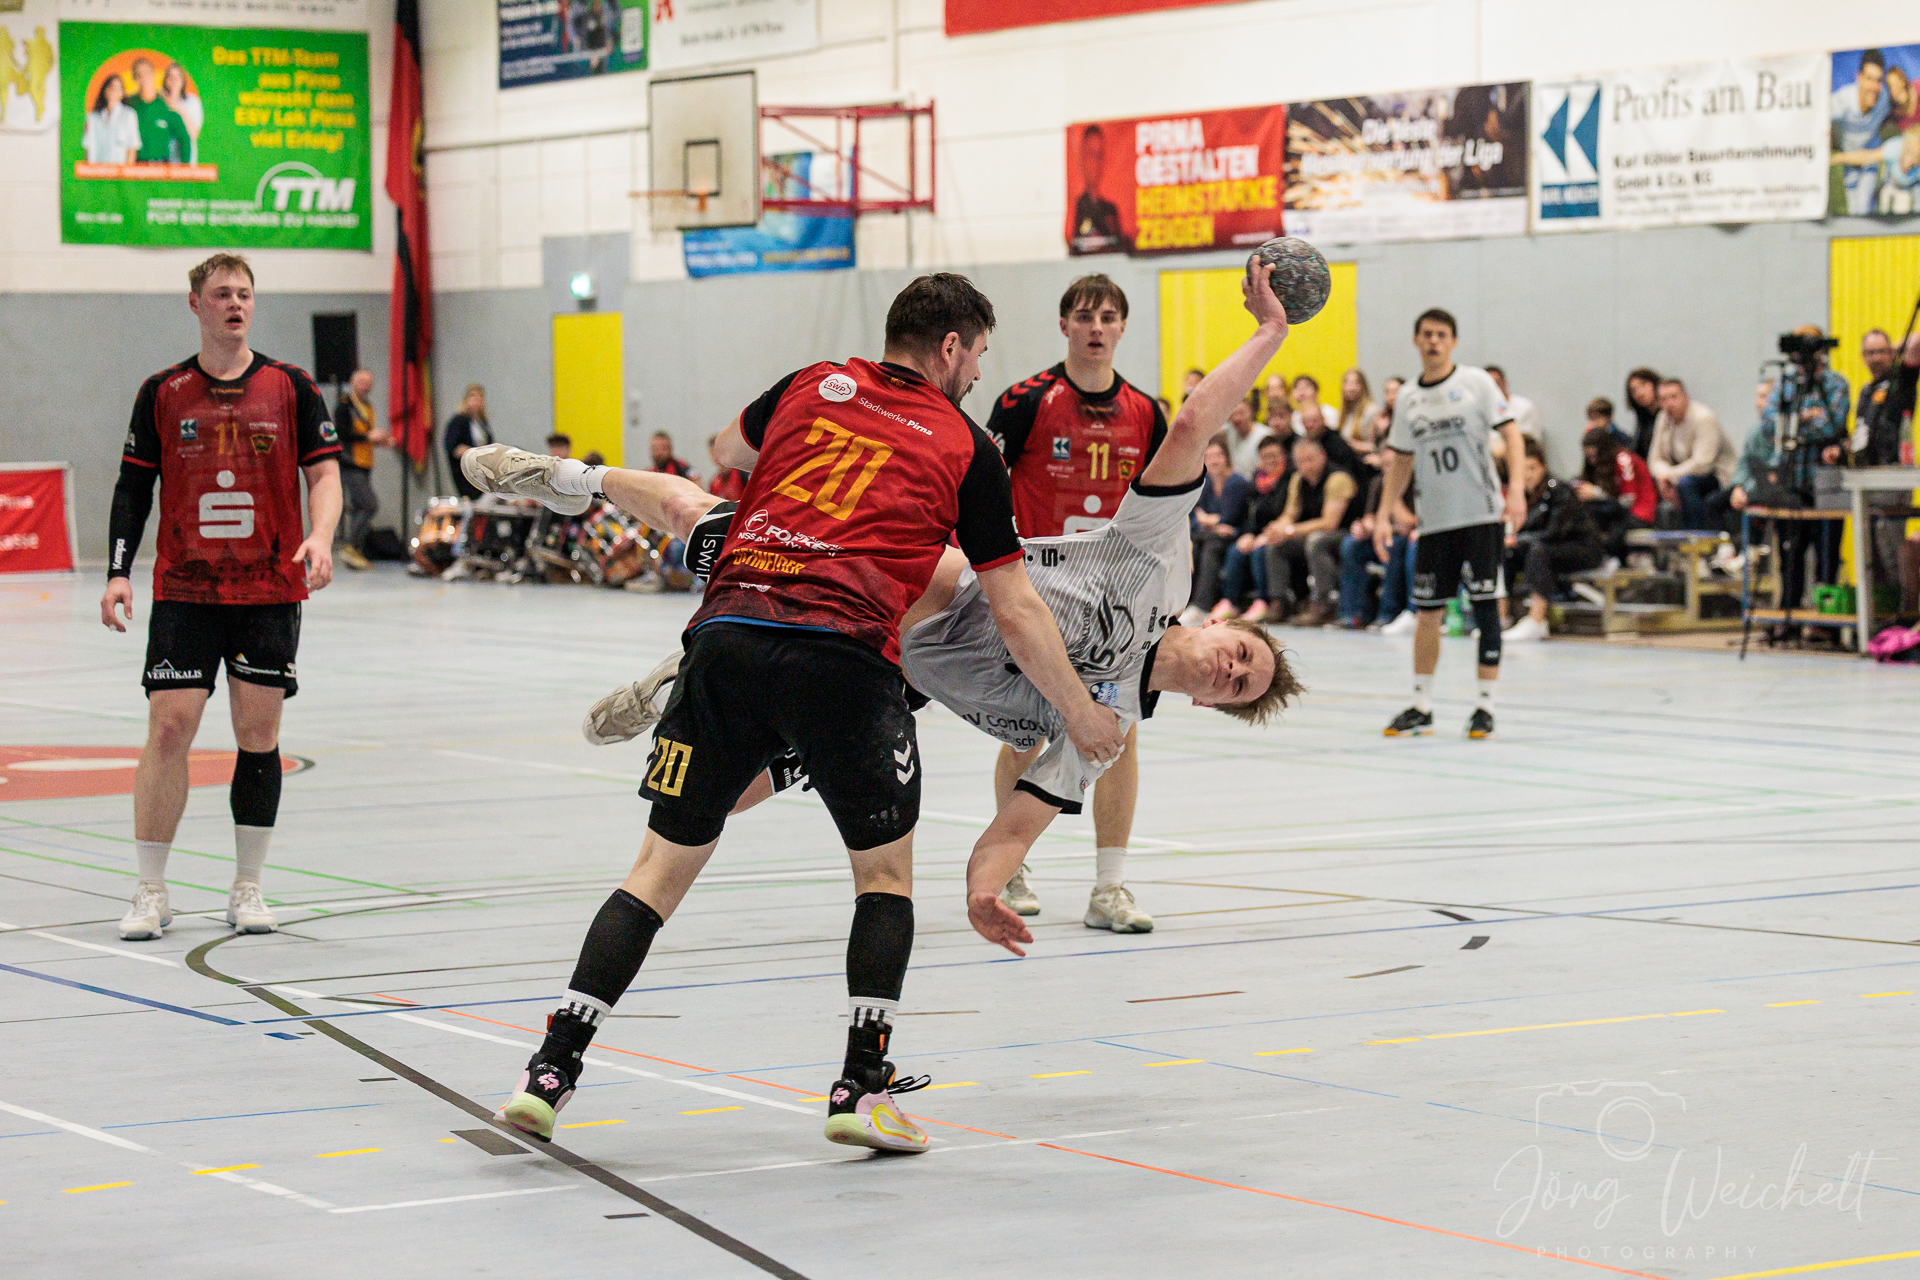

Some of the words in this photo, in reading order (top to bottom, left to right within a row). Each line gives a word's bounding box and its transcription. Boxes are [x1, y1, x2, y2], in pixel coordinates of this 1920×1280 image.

[212, 46, 248, 66] Das
[251, 46, 339, 68] TTM-Team
[258, 73, 291, 89] aus
[294, 70, 341, 90] Pirna
[239, 88, 312, 107] wünscht
[1612, 77, 1693, 123] Profis
[1702, 84, 1745, 117] am
[1756, 70, 1813, 113] Bau
[234, 107, 271, 126] ESV
[274, 108, 306, 127] Lok
[310, 109, 356, 128] Pirna
[1362, 118, 1391, 145] Die
[250, 130, 283, 149] viel
[286, 130, 344, 153] Erfolg!
[1136, 117, 1205, 156] PIRNA
[1136, 145, 1259, 186] GESTALTEN
[1464, 138, 1504, 172] Liga
[1688, 144, 1816, 166] Bauunternehmung
[270, 177, 356, 211] TTM
[1136, 175, 1278, 216] HEIMSTÄRKE
[1614, 175, 1650, 190] GmbH
[1694, 171, 1713, 185] KG
[1136, 215, 1215, 249] ZEIGEN
[828, 380, 847, 393] SWP
[858, 396, 907, 425] Stadtwerke
[907, 419, 933, 436] Pirna
[772, 416, 895, 521] 20
[1087, 442, 1110, 480] 11
[1430, 446, 1460, 475] 10
[112, 538, 126, 570] Kempa
[146, 669, 203, 680] VERTIKALIS
[646, 736, 694, 797] 20
[783, 767, 792, 787] erima
